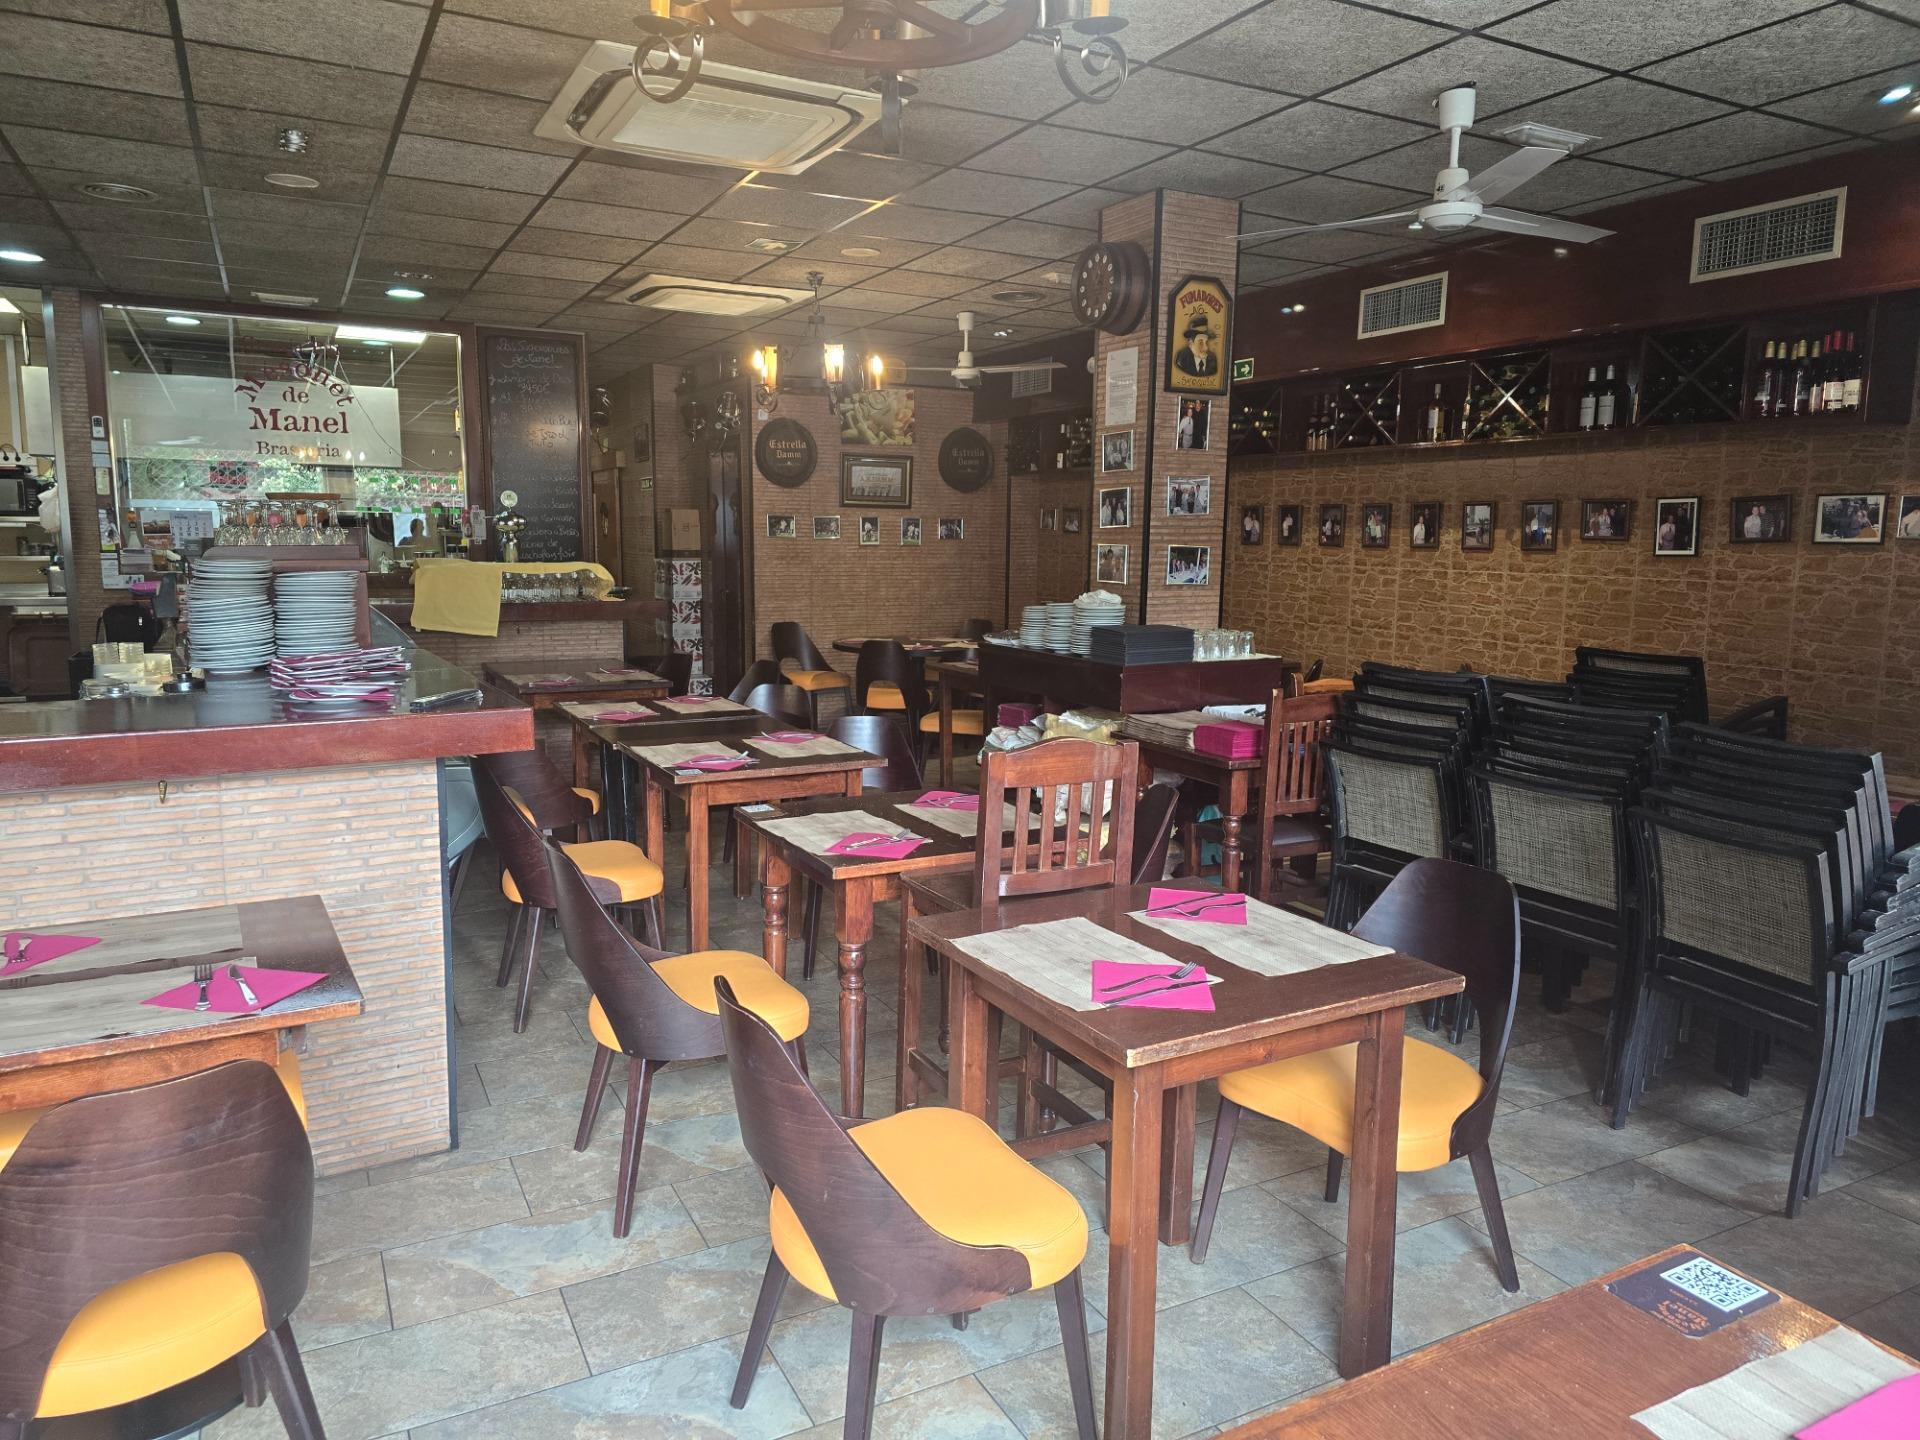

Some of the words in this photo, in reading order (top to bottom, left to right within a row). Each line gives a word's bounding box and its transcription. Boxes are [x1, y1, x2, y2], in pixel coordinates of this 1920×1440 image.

[282, 387, 309, 403] de
[248, 407, 350, 434] Manel
[769, 439, 807, 449] Estrella
